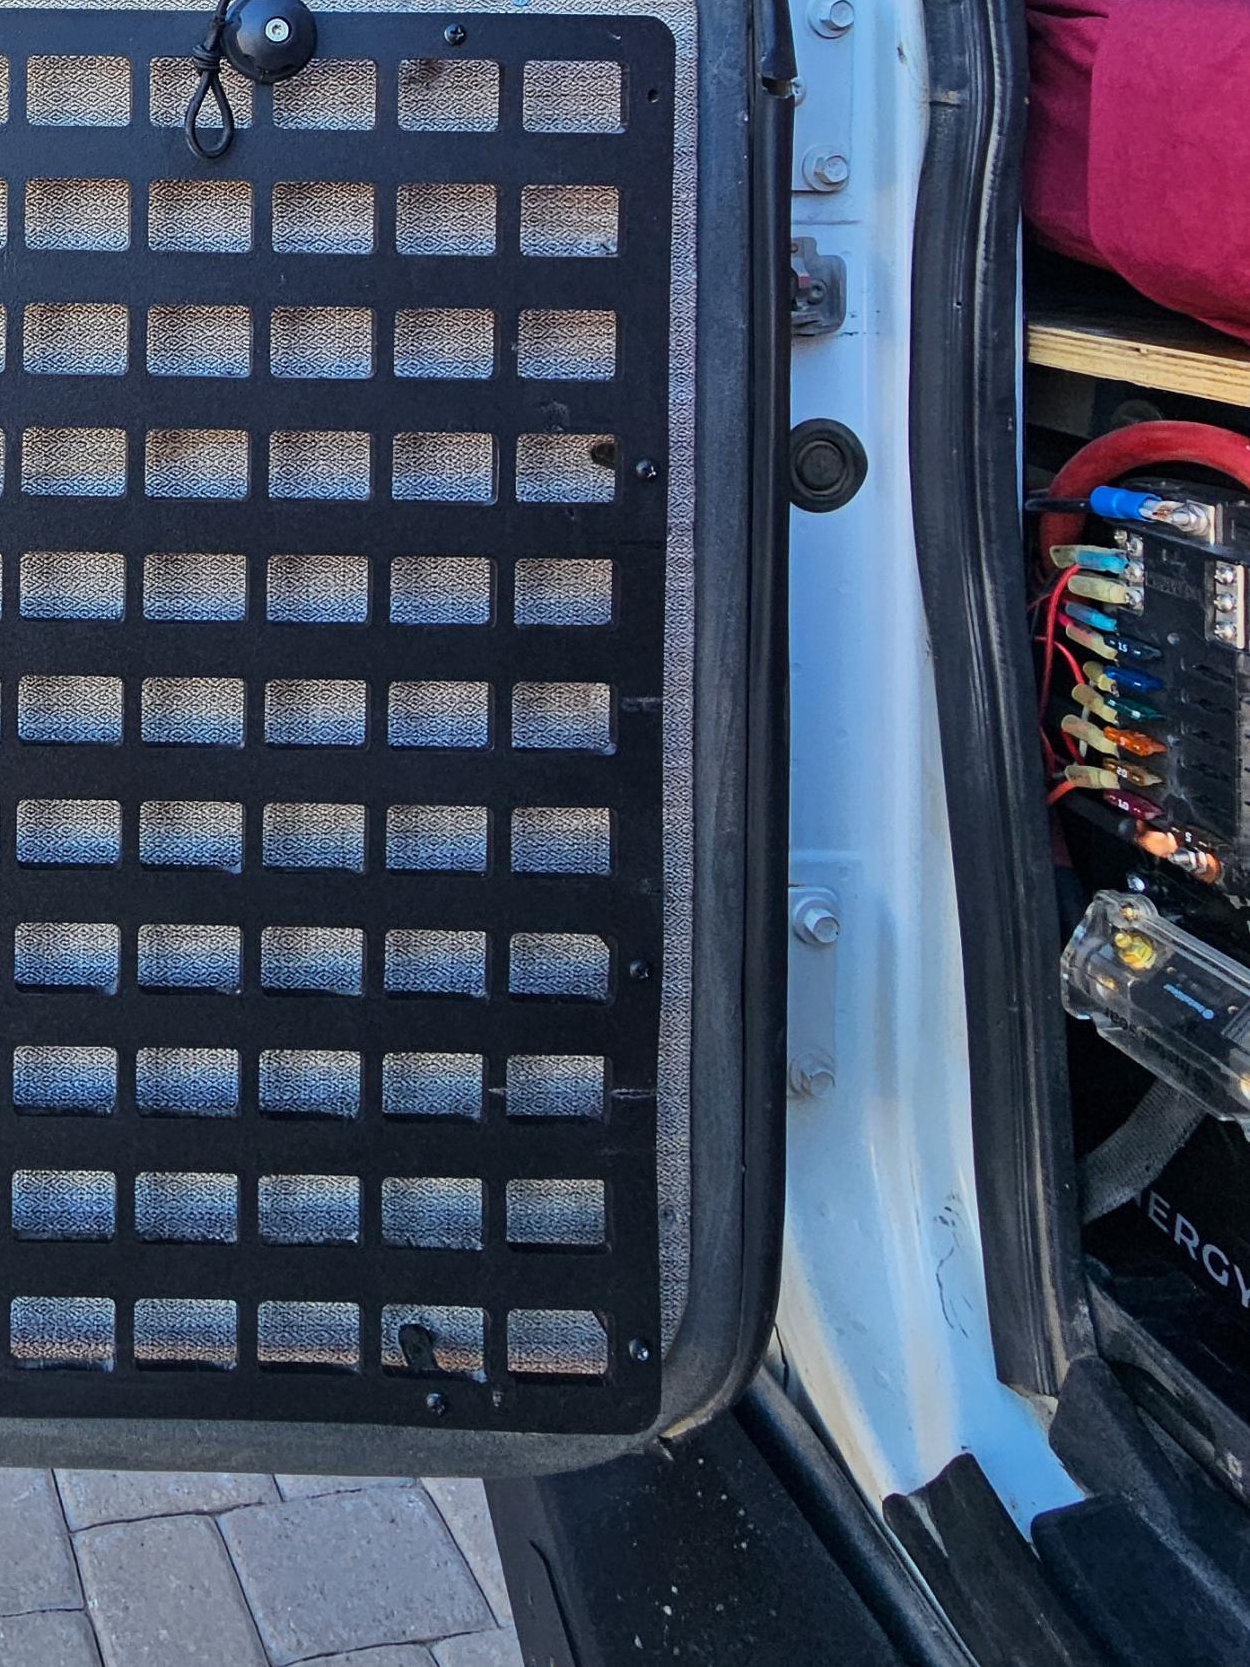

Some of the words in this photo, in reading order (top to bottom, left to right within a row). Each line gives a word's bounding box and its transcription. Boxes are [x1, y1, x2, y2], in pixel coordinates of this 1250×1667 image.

[1117, 641, 1128, 653] 15
[1116, 766, 1128, 778] 20
[1117, 798, 1130, 811] 10
[1134, 1191, 1250, 1308] ERGY
